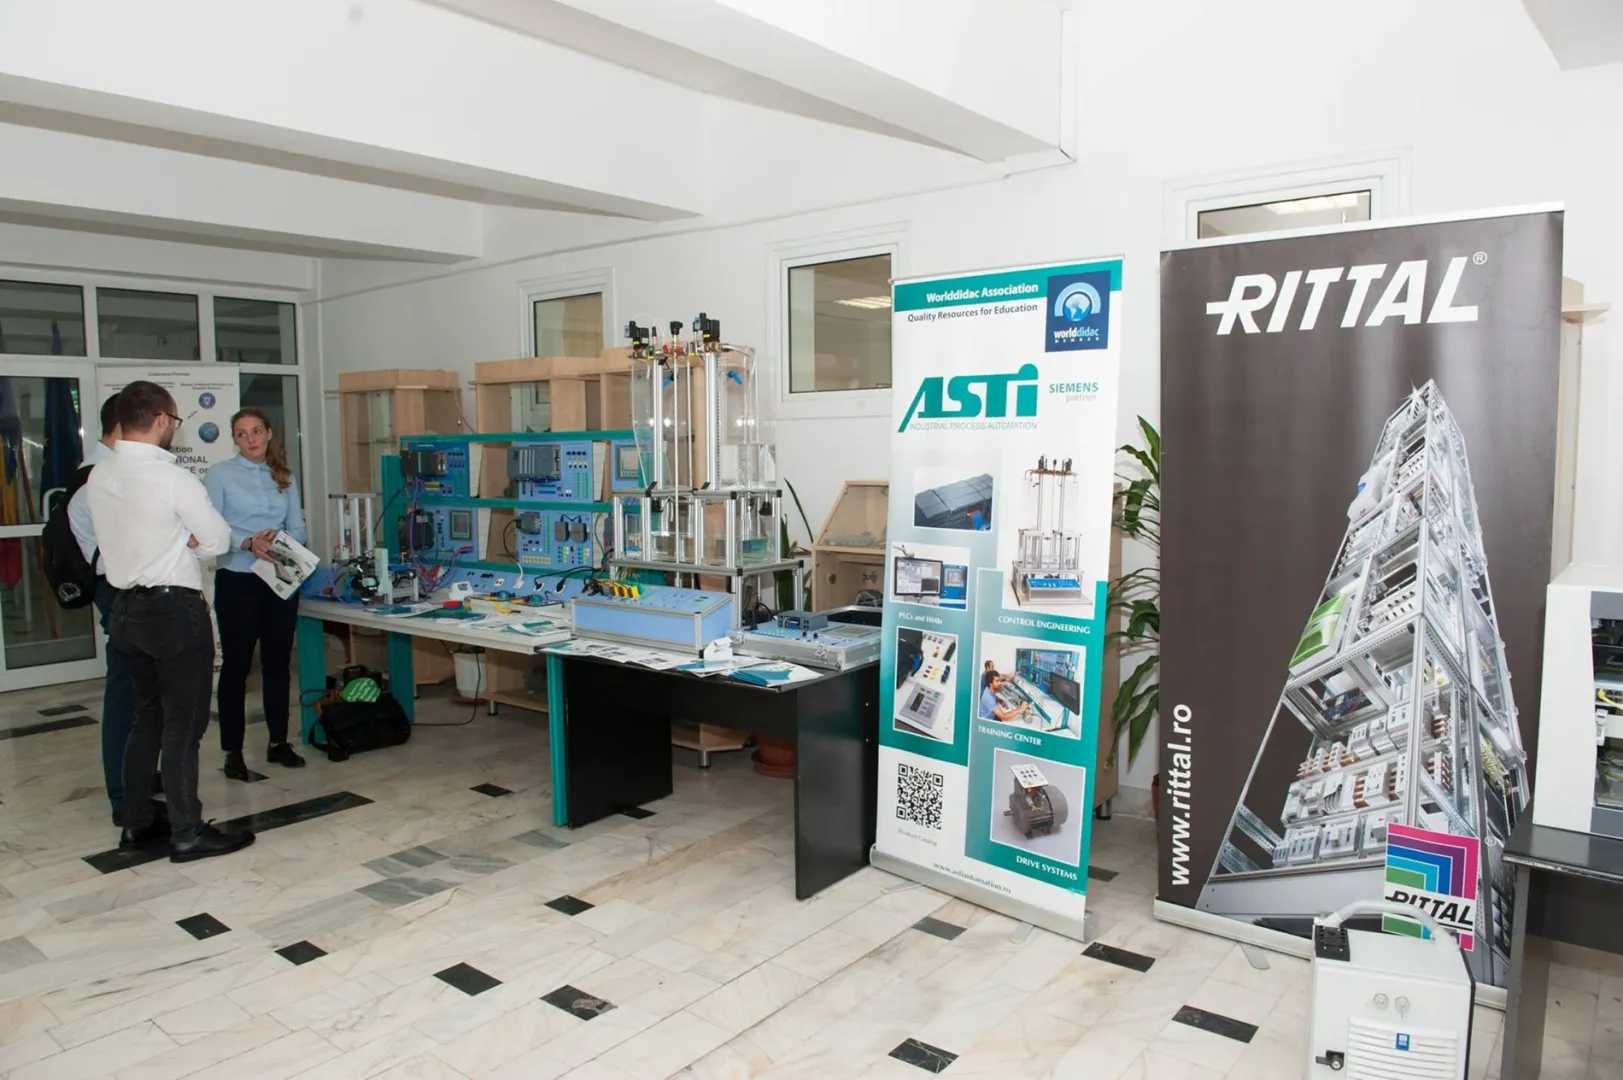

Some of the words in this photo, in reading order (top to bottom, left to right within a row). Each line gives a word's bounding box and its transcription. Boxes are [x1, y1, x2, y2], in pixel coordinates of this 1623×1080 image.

[926, 288, 980, 303] Worlddidac
[981, 283, 1039, 297] Association
[1206, 256, 1479, 336] RITTAL
[907, 312, 936, 323] Quality
[938, 309, 978, 320] Resources
[980, 307, 992, 316] for
[994, 303, 1038, 315] Education
[1053, 326, 1099, 339] worlddidac
[1049, 382, 1099, 394] SIEMENS
[1066, 394, 1096, 404] partner
[910, 422, 949, 431] INDUSTRIAL
[950, 421, 987, 431] PROCESS
[987, 421, 1038, 430] AUTOMATION
[898, 611, 913, 621] PLCs
[914, 613, 925, 623] and
[998, 616, 1035, 628] CONTROL
[1036, 620, 1091, 635] ENGINEERING
[978, 725, 1014, 740] TRAINING
[1014, 733, 1042, 746] CENTER
[1166, 703, 1192, 886] www.rittal.ro
[1016, 855, 1040, 870] DRIVE
[1041, 863, 1078, 881] SYSTEMS
